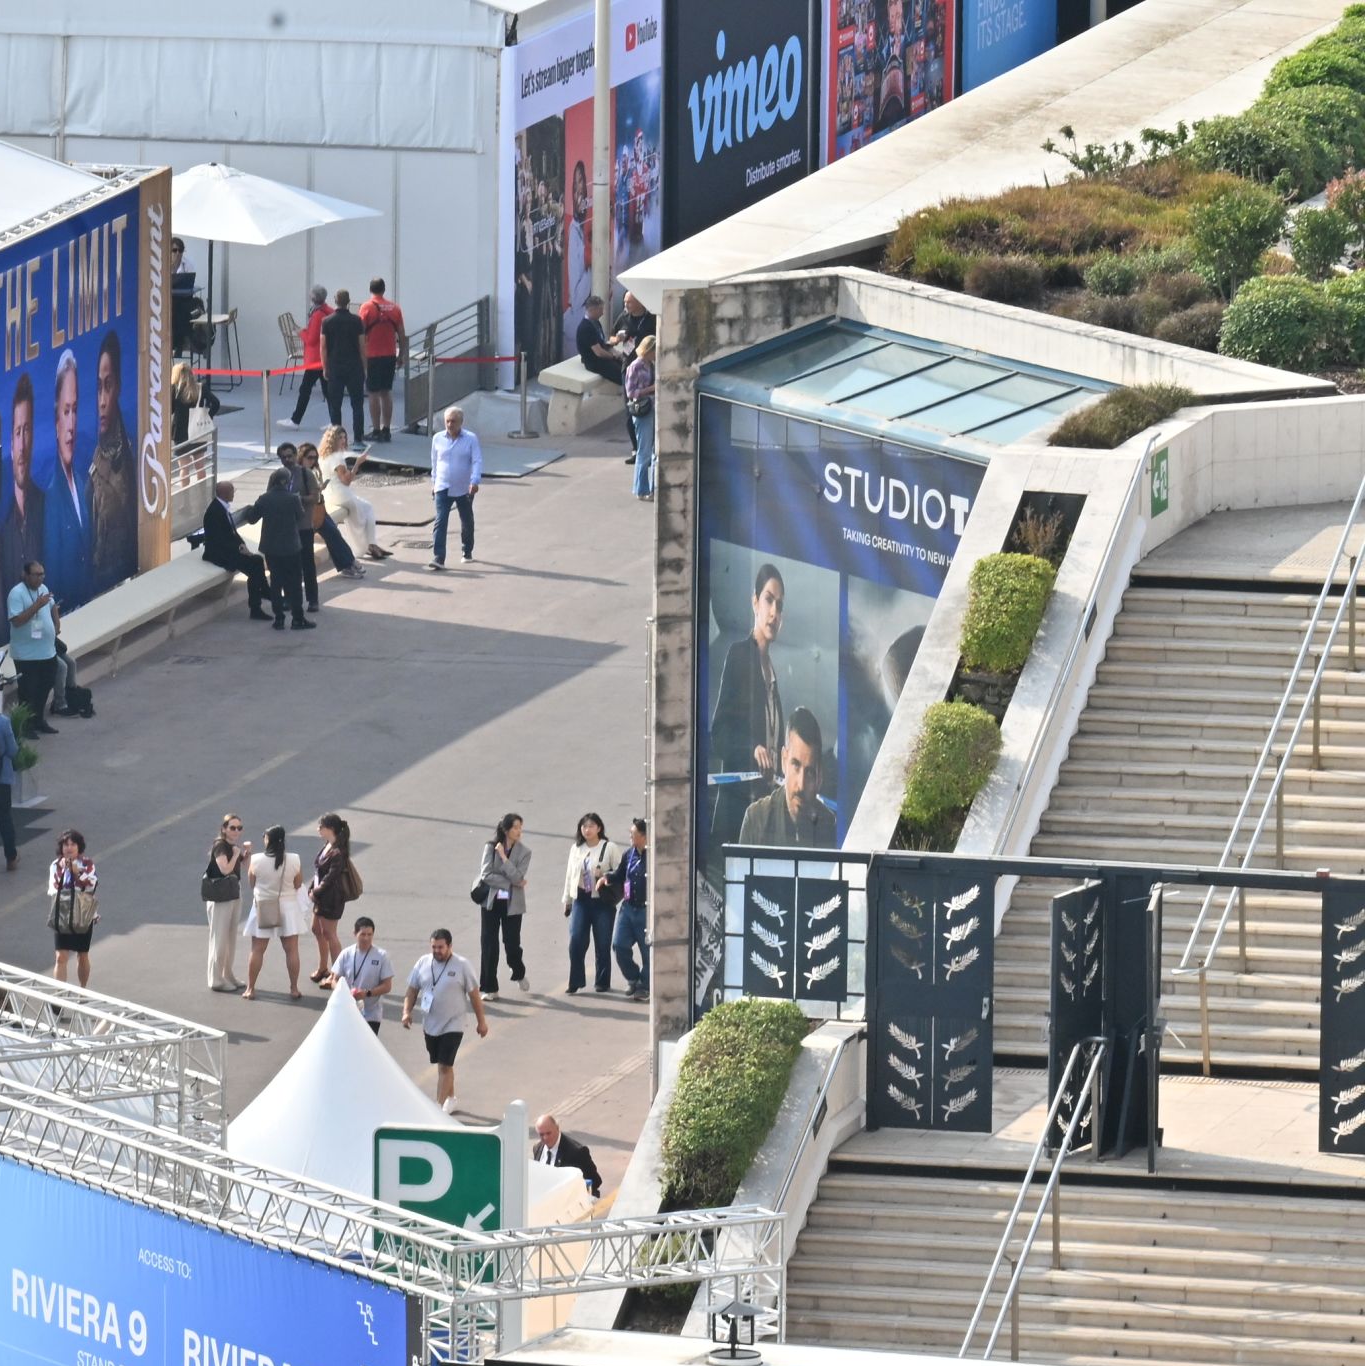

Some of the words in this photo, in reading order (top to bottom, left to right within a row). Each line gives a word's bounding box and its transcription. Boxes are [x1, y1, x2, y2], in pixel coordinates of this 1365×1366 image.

[637, 16, 658, 46] YouTube
[977, 17, 992, 50] ITS
[995, 0, 1026, 42] STAGE.
[521, 69, 535, 99] Let's
[536, 64, 557, 92] stream
[557, 55, 575, 85] bigger
[576, 42, 596, 76] togeth
[688, 30, 802, 163] vimeo
[745, 160, 776, 187] Distribute
[776, 148, 801, 174] smarter.
[50, 213, 129, 350] LIMIT
[139, 203, 171, 518] Paramount
[823, 462, 969, 536] STUDIOT
[842, 527, 871, 546] TAKING
[872, 535, 915, 558] CREATIVITY
[915, 547, 926, 561] TO
[927, 550, 946, 566] NEW
[379, 1138, 453, 1232] P
[138, 1247, 174, 1276] ACCESS
[175, 1258, 191, 1280] TO:
[11, 1268, 123, 1352] RIVIERA
[128, 1309, 147, 1357] 9
